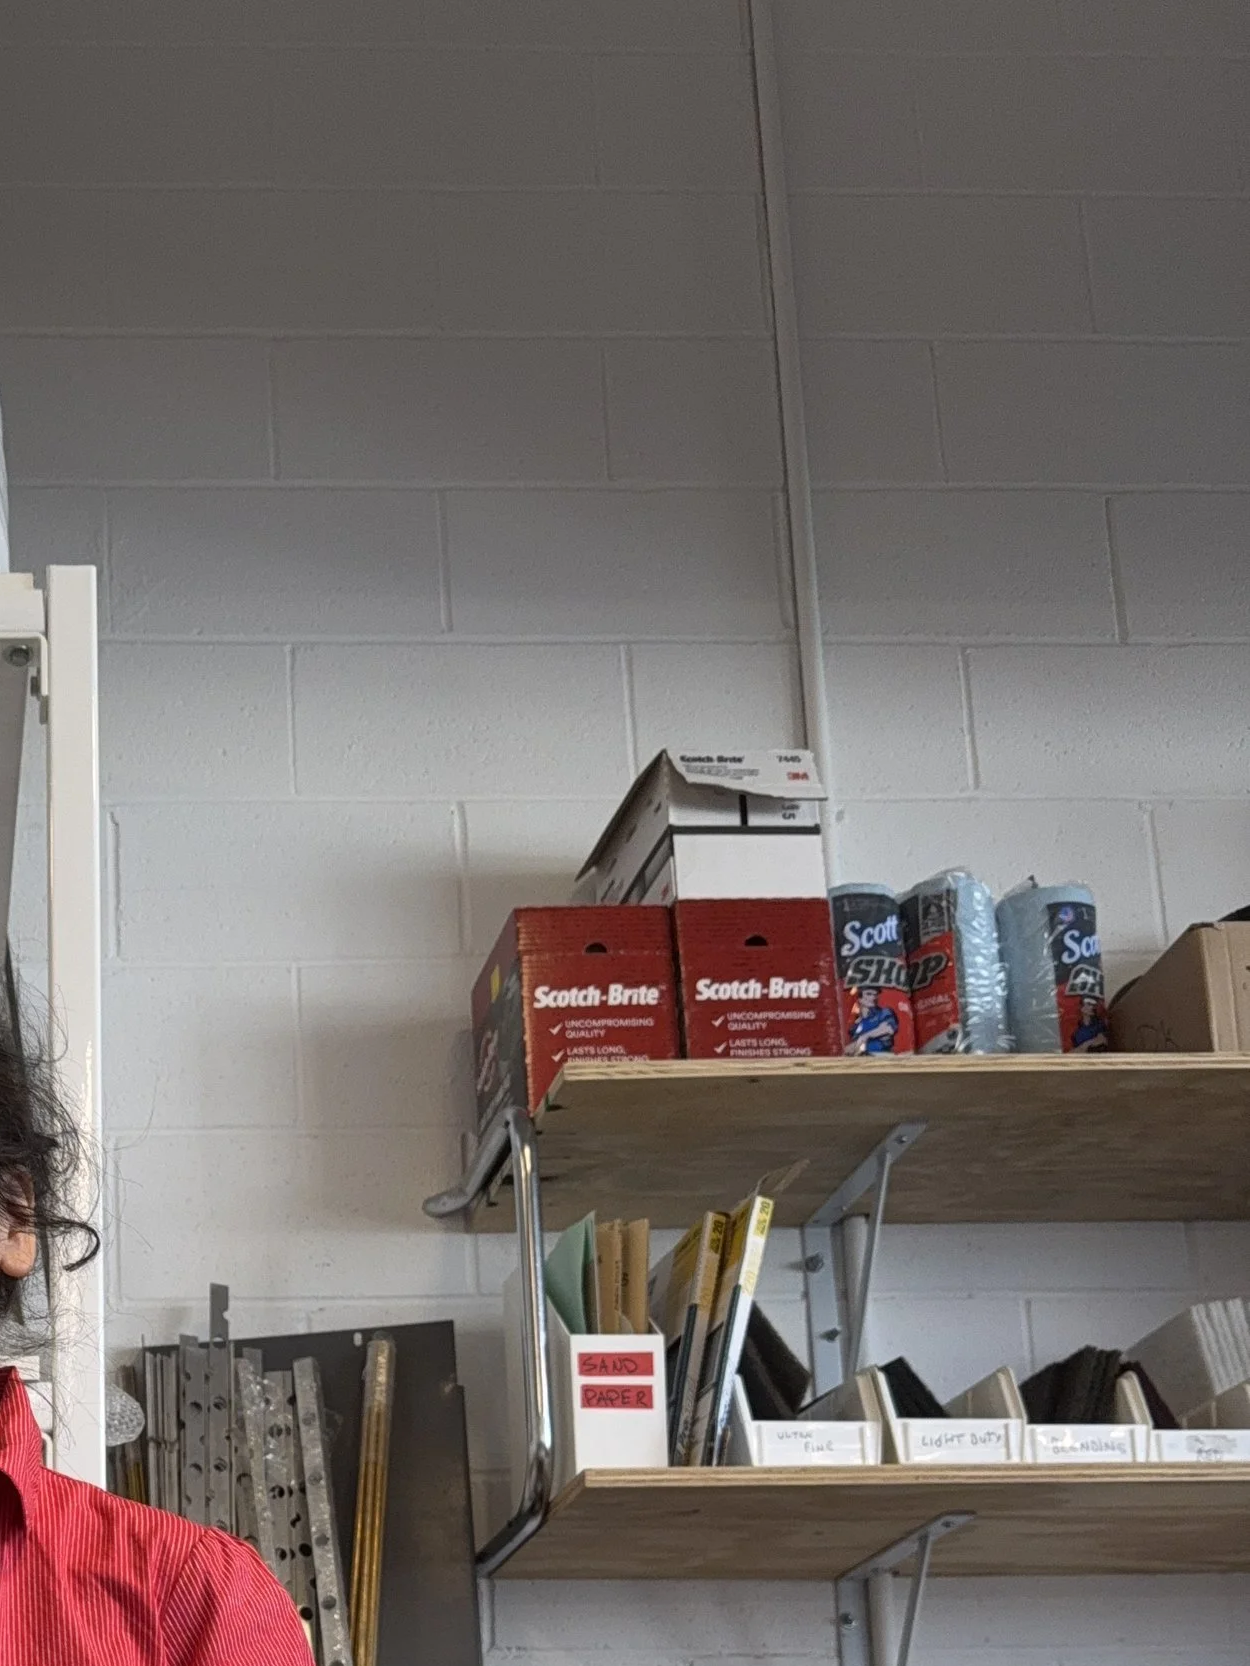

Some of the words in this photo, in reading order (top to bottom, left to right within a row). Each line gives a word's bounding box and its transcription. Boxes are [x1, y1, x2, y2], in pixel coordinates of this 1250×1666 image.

[841, 914, 899, 956] Scott
[695, 976, 820, 1001] Scotch-Brite
[533, 983, 659, 1008] Scotch-Brite
[726, 1011, 816, 1021] UNCOMPROMISING
[564, 1017, 655, 1029] UNCOMPROMISING
[727, 1021, 768, 1031] QUALITY
[565, 1029, 606, 1039] QUALITY
[729, 1038, 757, 1048] LASTS
[566, 1046, 595, 1056] LASTS
[730, 1048, 771, 1057] FINISHES
[582, 1356, 638, 1374] SAND
[584, 1388, 647, 1408] PAPER
[970, 1430, 1002, 1446] DUTY
